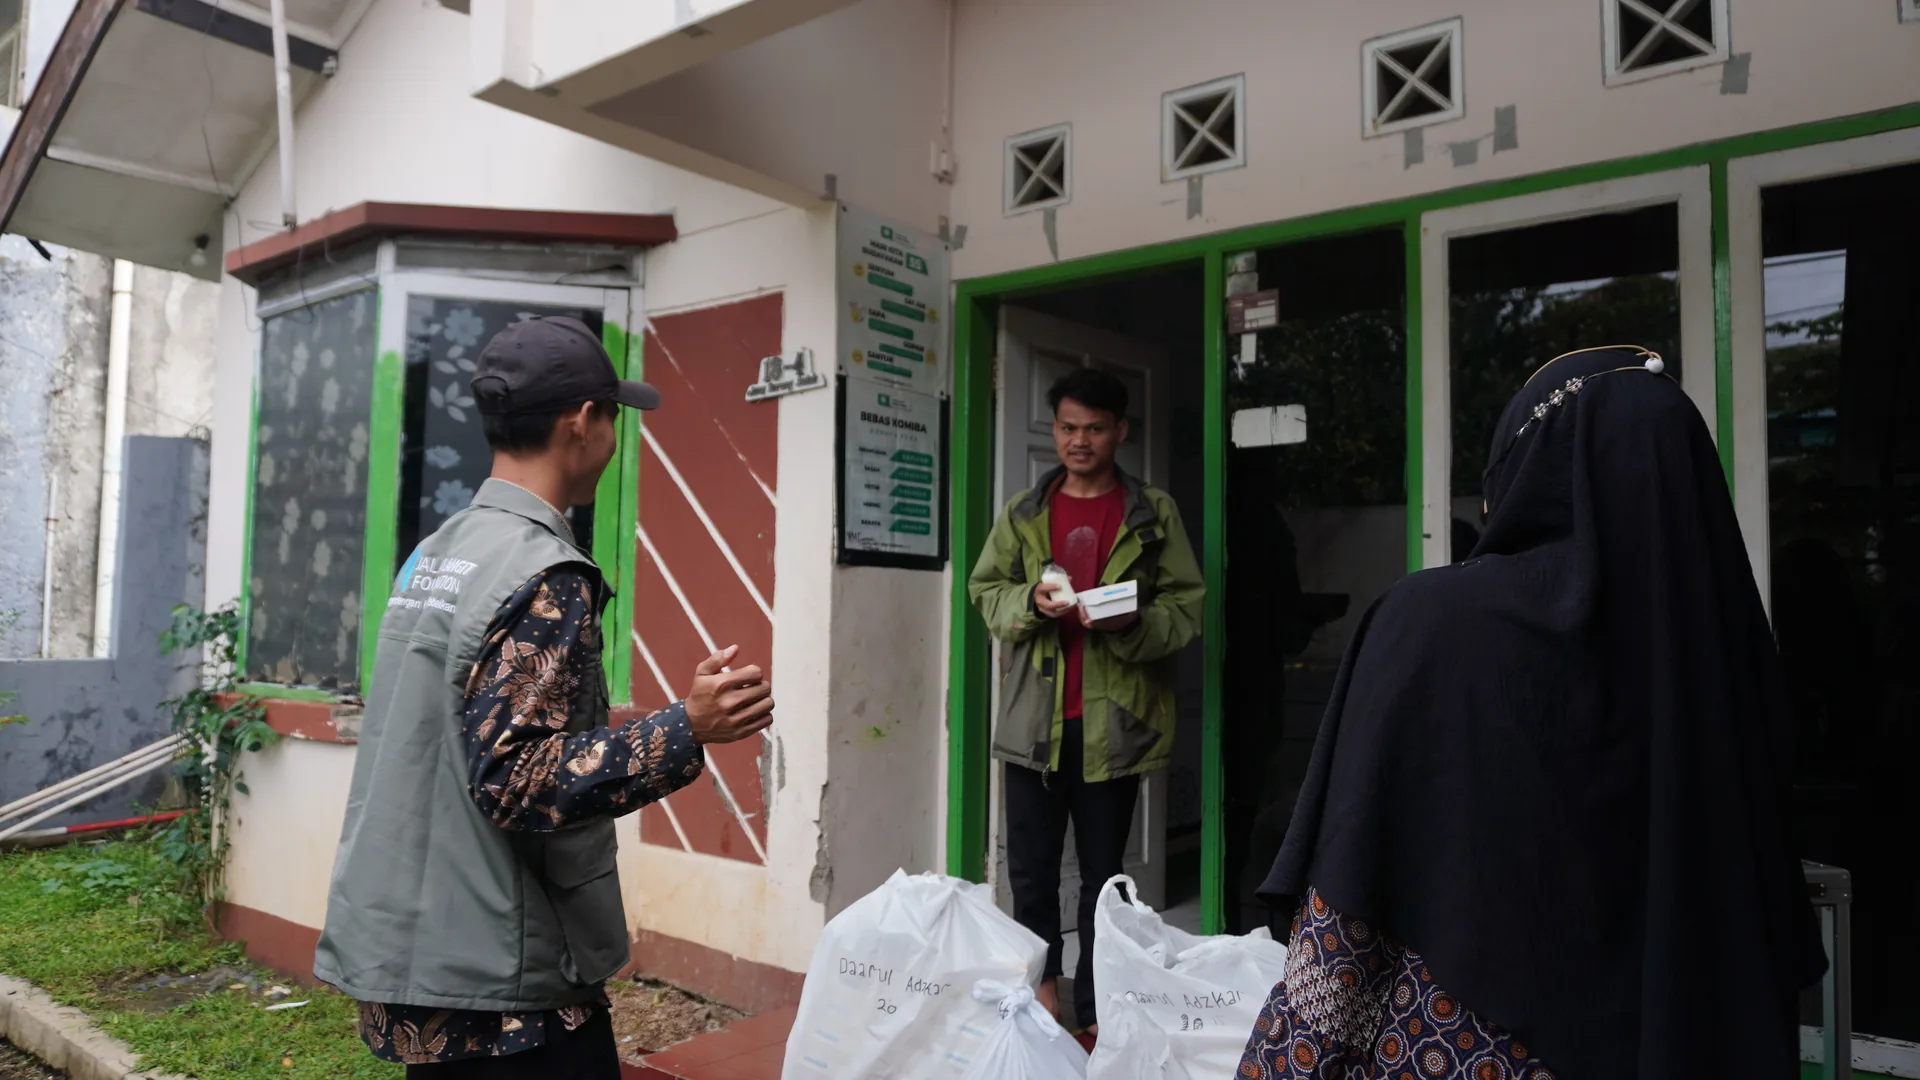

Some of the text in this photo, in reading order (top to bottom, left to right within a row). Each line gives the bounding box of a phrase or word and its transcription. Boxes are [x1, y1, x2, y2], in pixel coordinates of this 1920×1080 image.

[860, 411, 928, 434] BEBAS KOMIBA
[839, 957, 893, 986] Daarul
[877, 998, 897, 1015] 20
